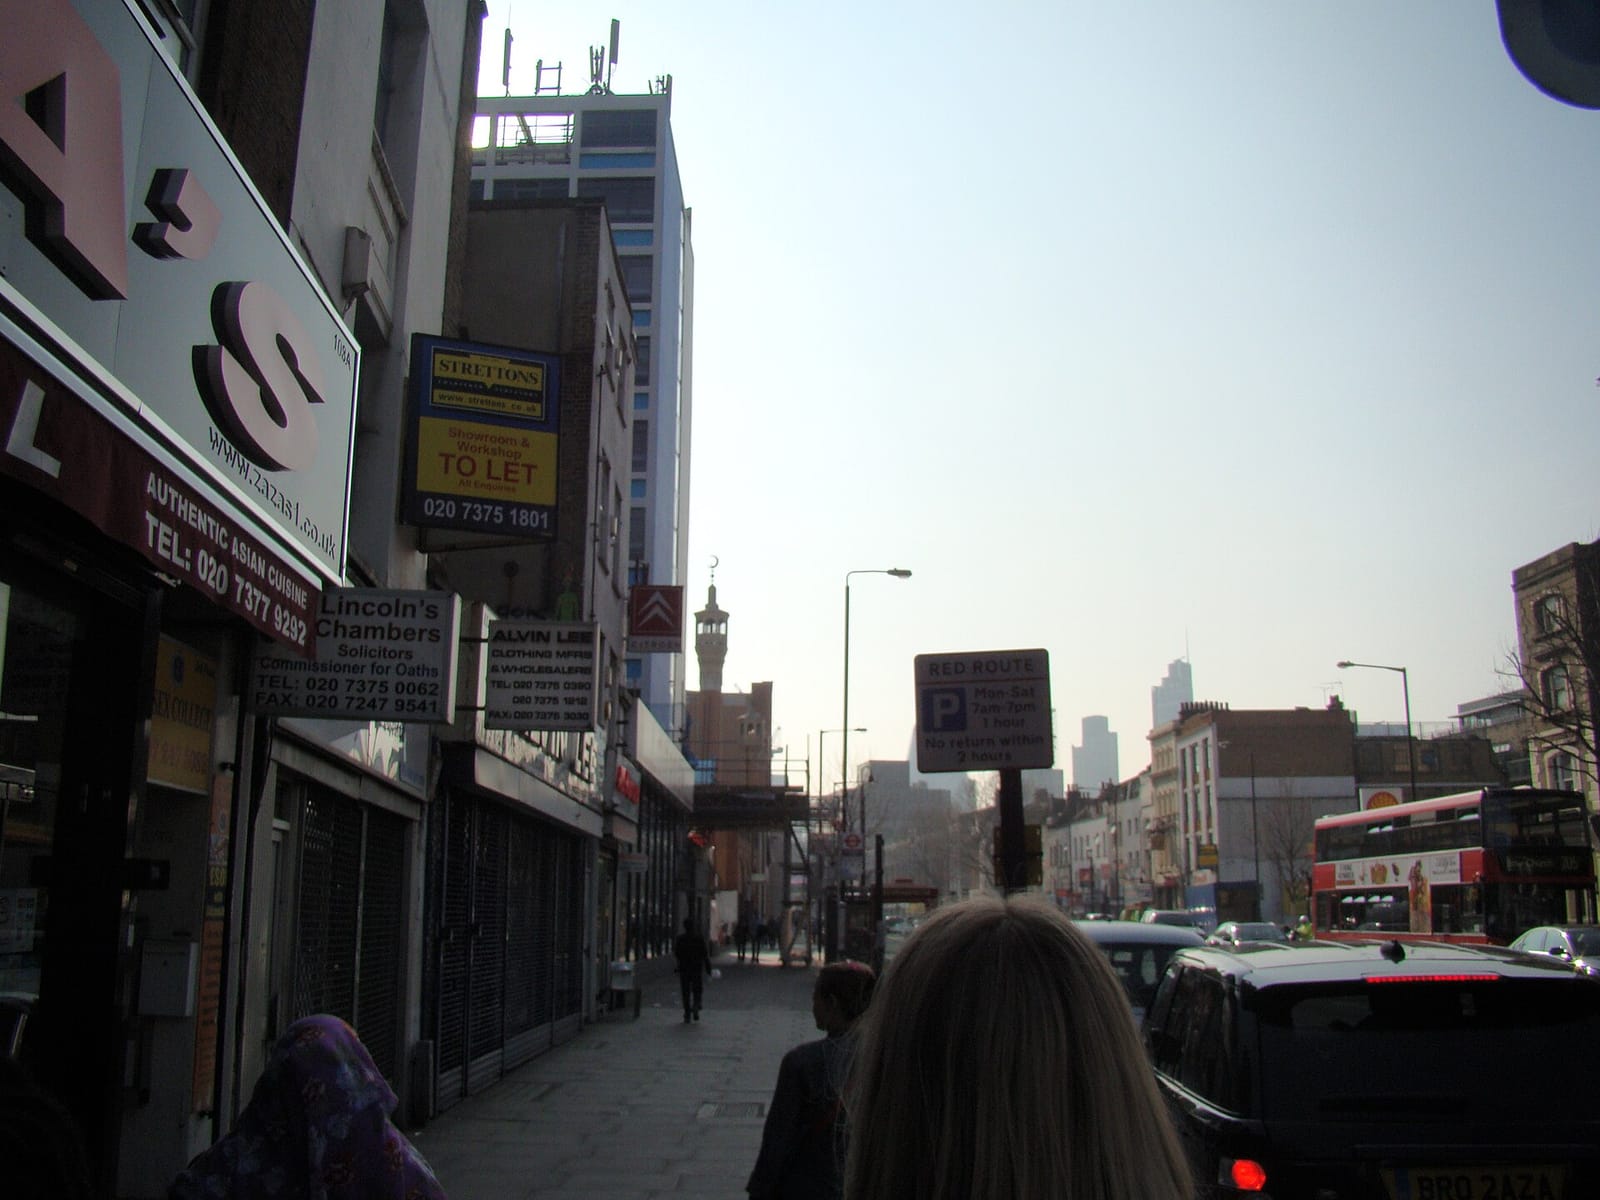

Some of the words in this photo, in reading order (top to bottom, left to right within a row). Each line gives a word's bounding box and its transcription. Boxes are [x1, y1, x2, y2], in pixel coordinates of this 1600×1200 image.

[334, 334, 351, 371] 108A
[438, 359, 539, 386] STRETTONS
[448, 427, 517, 445] Showroom
[520, 437, 530, 449] &
[457, 441, 522, 460] Workshop
[438, 452, 477, 477] TO
[486, 458, 538, 485] LET
[424, 498, 456, 518] 020
[462, 501, 504, 525] 7375
[510, 508, 549, 529] 1801
[146, 471, 229, 550] AUTHENTIC
[231, 535, 266, 580] ASIAN
[267, 565, 308, 611] CUISINE
[145, 509, 193, 572] TEL:
[197, 548, 230, 595] 020
[234, 573, 272, 623] 7377
[274, 603, 307, 647] 9292
[321, 596, 439, 619] Lincoln's
[316, 618, 441, 643] Chambers
[492, 630, 551, 643] ALVIN
[556, 631, 593, 644] LEE
[338, 644, 413, 660] Solicitors
[491, 650, 553, 659] CLOTHING
[555, 650, 593, 660] MFRS
[259, 655, 366, 675] Commissioner
[370, 662, 390, 676] for
[395, 663, 439, 678] Oaths
[501, 664, 593, 675] WHOLESALERS
[929, 661, 966, 676] RED
[973, 657, 1034, 674] ROUTE
[255, 674, 299, 691] TEL:
[306, 678, 338, 692] 020
[345, 679, 389, 695] 7375
[395, 681, 439, 697] 0062
[513, 681, 533, 690] 020
[534, 681, 560, 690] 7375
[254, 691, 299, 707] FAX:
[305, 695, 338, 709] 020
[344, 696, 388, 711] 7247
[394, 699, 438, 713] 9541
[512, 696, 532, 705] 020
[534, 696, 559, 705] 7375
[513, 711, 533, 720] 020
[983, 718, 989, 729] 1
[993, 717, 1025, 729] hour
[925, 737, 945, 749] No
[951, 735, 995, 749] return
[999, 734, 1044, 746] within
[958, 751, 966, 763] 2
[971, 750, 1012, 762] hours
